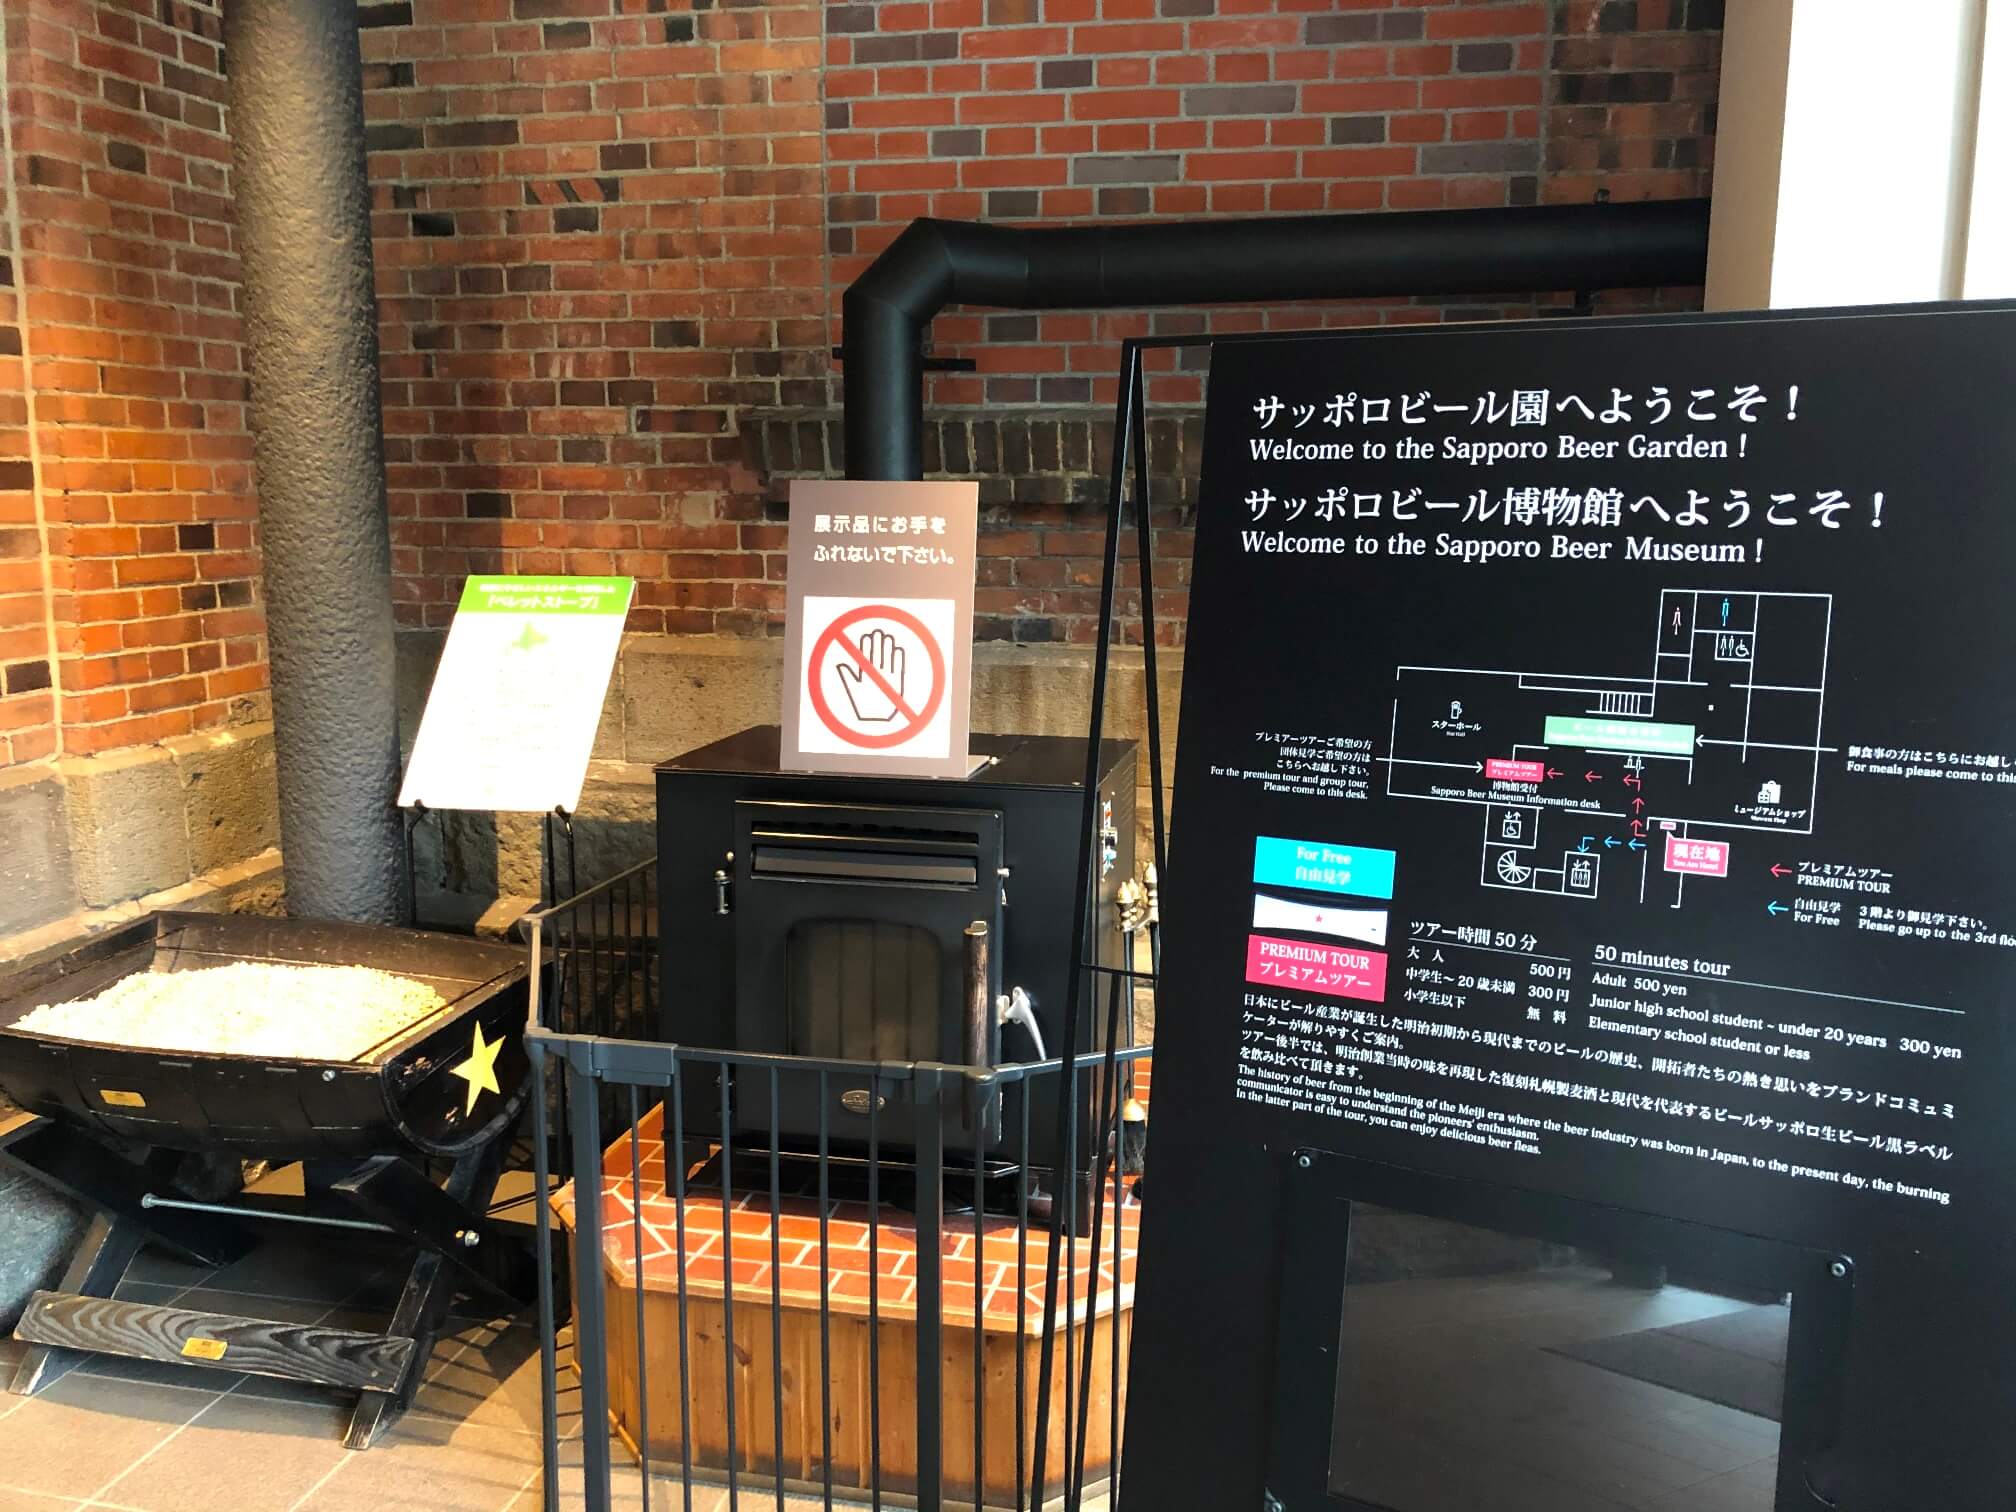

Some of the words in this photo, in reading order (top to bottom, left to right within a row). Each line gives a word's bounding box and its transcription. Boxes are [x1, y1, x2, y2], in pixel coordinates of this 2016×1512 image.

[1250, 439, 1353, 460] Welcome
[1363, 440, 1385, 459] to
[1396, 437, 1434, 459] the
[1443, 437, 1547, 464] Sapporo
[1557, 436, 1619, 458] Beer
[815, 515, 945, 533] 展示品にお手を
[814, 545, 953, 564] ふれないで下さい。
[1242, 531, 1345, 553] Welcome
[1356, 535, 1378, 554] to
[1388, 533, 1426, 555] the
[1436, 533, 1540, 562] Sapporo
[1551, 535, 1612, 558] Beer
[1432, 721, 1481, 731] スターホール
[1256, 732, 1372, 750] プレミアーツアーご希望の方
[1280, 747, 1370, 762] 団体見学ご希望の方は
[1848, 746, 2016, 768] 御食事の方はこちらにお越し
[1211, 766, 1224, 775] For
[1227, 768, 1239, 776] the
[1243, 771, 1280, 784] premium
[1283, 774, 1301, 782] tour
[1303, 775, 1318, 784] and
[1320, 778, 1346, 790] group
[1349, 780, 1368, 792] tour.
[1277, 760, 1369, 776] こちらへお越し下さい。
[1847, 761, 1866, 772] For
[1869, 764, 1902, 774] meals
[1905, 765, 1943, 778] please
[1946, 771, 1978, 780] come
[1981, 772, 1993, 781] to
[1264, 782, 1290, 792] Please
[1328, 788, 1343, 797] this
[1346, 789, 1367, 799] desk.
[1430, 786, 1466, 800] Sapporo
[1468, 789, 1486, 800] Beer
[1488, 791, 1525, 803] Museum
[1527, 795, 1578, 807] Information
[1580, 799, 1600, 809] desk
[1735, 805, 1806, 818] ミュージアムショップ
[1297, 846, 1319, 861] For
[1322, 848, 1352, 864] Free
[1296, 866, 1351, 885] 自由見学
[1798, 862, 1893, 878] プレミアムツアー
[1798, 874, 1854, 890] PREMIUM
[1857, 881, 1890, 893] TOUR
[1795, 898, 1841, 916] 自由見学
[1794, 911, 1813, 922] For
[1816, 914, 1840, 926] Free
[1859, 919, 1895, 932] Please
[1898, 926, 1912, 936] go
[1916, 928, 1931, 939] up
[1934, 928, 1946, 938] to
[1951, 929, 1970, 941] the
[1975, 932, 1996, 944] 3rd
[1260, 942, 1327, 964] PREMIUM
[1330, 952, 1369, 970] TOUR
[1595, 945, 1616, 960] 50
[1622, 951, 1688, 970] minutes
[1694, 959, 1730, 975] tour
[1260, 962, 1371, 987] プレミアムツアー
[1592, 972, 1626, 987] Adult
[1634, 978, 1660, 992] 500
[1662, 984, 1686, 996] yen
[1404, 988, 1466, 1008] 小学生以下
[1243, 1011, 1403, 1054] ケーターが解りやすくご案内。
[1590, 994, 1631, 1010] Junior
[1634, 1000, 1663, 1017] high
[1666, 1006, 1709, 1022] school
[1712, 1014, 1763, 1029] student
[1779, 1023, 1820, 1037] under
[1824, 1027, 1843, 1041] 20
[1846, 1033, 1887, 1047] years
[1900, 1038, 1930, 1053] 300
[1933, 1046, 1961, 1059] yen
[1589, 1016, 1661, 1040] Elementary
[1664, 1029, 1706, 1045] school
[1710, 1036, 1761, 1053] student
[1765, 1045, 1780, 1055] or
[1784, 1045, 1810, 1060] less
[1240, 1046, 1363, 1080] を飲み比べて頂きます。
[1237, 1079, 1303, 1096] communicator
[1306, 1089, 1313, 1099] is
[1316, 1093, 1337, 1106] easy
[1340, 1096, 1349, 1105] to
[1352, 1100, 1407, 1116] understand
[1410, 1109, 1426, 1120] the
[1477, 1123, 1539, 1141] enthusiasm.
[1237, 1088, 1245, 1098] In
[1248, 1091, 1263, 1101] the
[1265, 1093, 1290, 1106] latter
[1293, 1101, 1312, 1111] part
[1314, 1104, 1325, 1113] of
[1327, 1105, 1342, 1116] the
[1345, 1110, 1367, 1122] tour,
[1369, 1116, 1388, 1126] you
[1390, 1120, 1407, 1129] can
[1410, 1123, 1438, 1137] enjoy
[1440, 1127, 1485, 1144] delicious
[1488, 1135, 1512, 1148] beer
[1514, 1141, 1541, 1154] fleas.
[1238, 1064, 1255, 1075] The
[1258, 1067, 1291, 1083] history
[1293, 1075, 1304, 1084] of
[1305, 1077, 1327, 1089] beer
[1329, 1080, 1352, 1094] from
[1355, 1085, 1371, 1097] the
[1373, 1088, 1423, 1108] beginning
[1426, 1099, 1438, 1109] of
[1440, 1101, 1456, 1112] the
[1458, 1104, 1484, 1119] Meiji
[1487, 1112, 1504, 1121] era
[1508, 1114, 1541, 1127] where
[1544, 1119, 1561, 1131] the
[1564, 1122, 1589, 1136] beer
[1592, 1128, 1638, 1147] industry
[1641, 1138, 1663, 1149] was
[1666, 1140, 1693, 1155] born
[1696, 1146, 1708, 1158] in
[1710, 1148, 1749, 1166] Japan,
[1753, 1157, 1765, 1168] to
[1768, 1159, 1788, 1172] the
[1791, 1166, 1839, 1182] present
[1842, 1173, 1868, 1188] day,
[1872, 1178, 1893, 1191] the
[1897, 1182, 1949, 1204] burning
